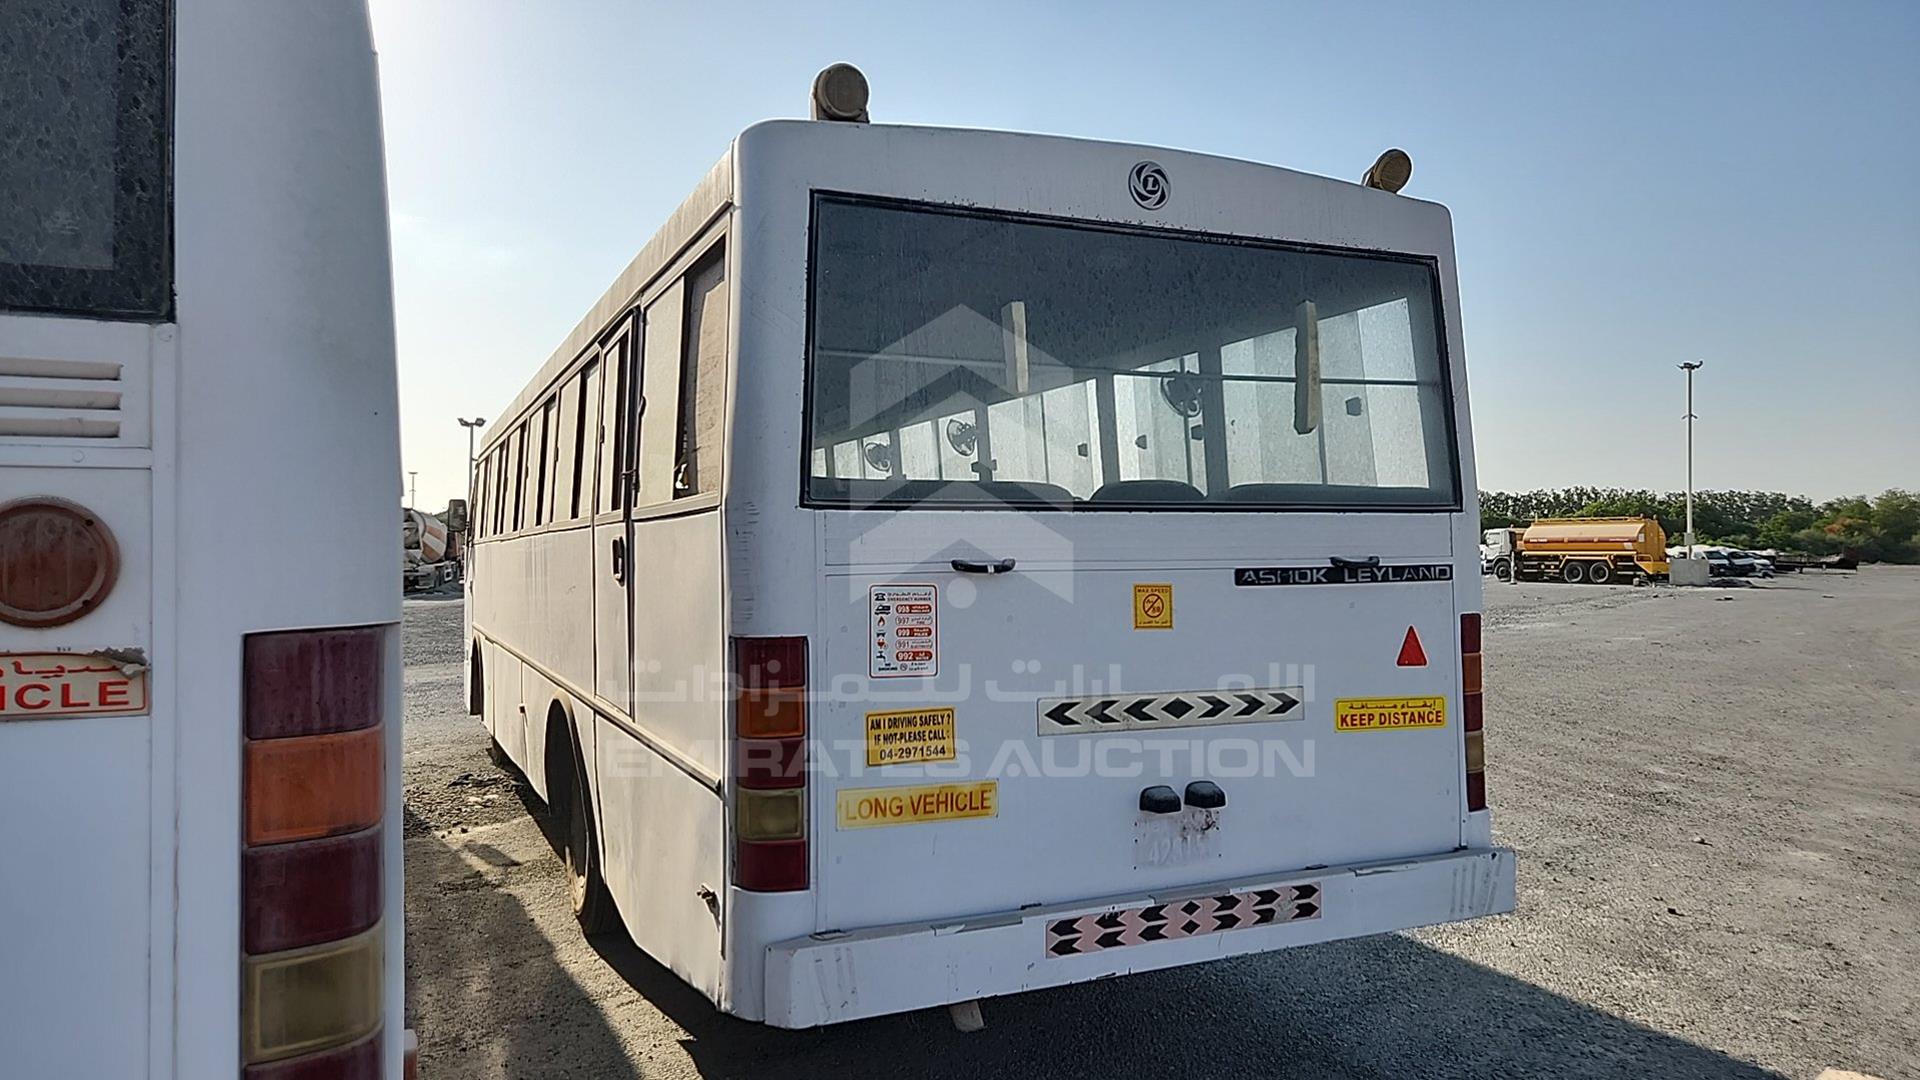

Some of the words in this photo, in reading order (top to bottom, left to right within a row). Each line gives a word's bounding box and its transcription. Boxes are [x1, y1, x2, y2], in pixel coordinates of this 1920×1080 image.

[1241, 568, 1328, 584] ASHOK
[1344, 566, 1450, 582] LEYLAND
[898, 652, 913, 660] 992
[870, 718, 881, 730] AM
[888, 715, 918, 729] DRIVING
[1340, 713, 1375, 727] KEEP
[1379, 710, 1442, 725] DISTANCE
[874, 734, 881, 746] IF
[928, 729, 946, 740] CALL
[880, 745, 946, 760] 04-2971544
[846, 796, 904, 820] LONG
[909, 789, 992, 816] VEHICLE
